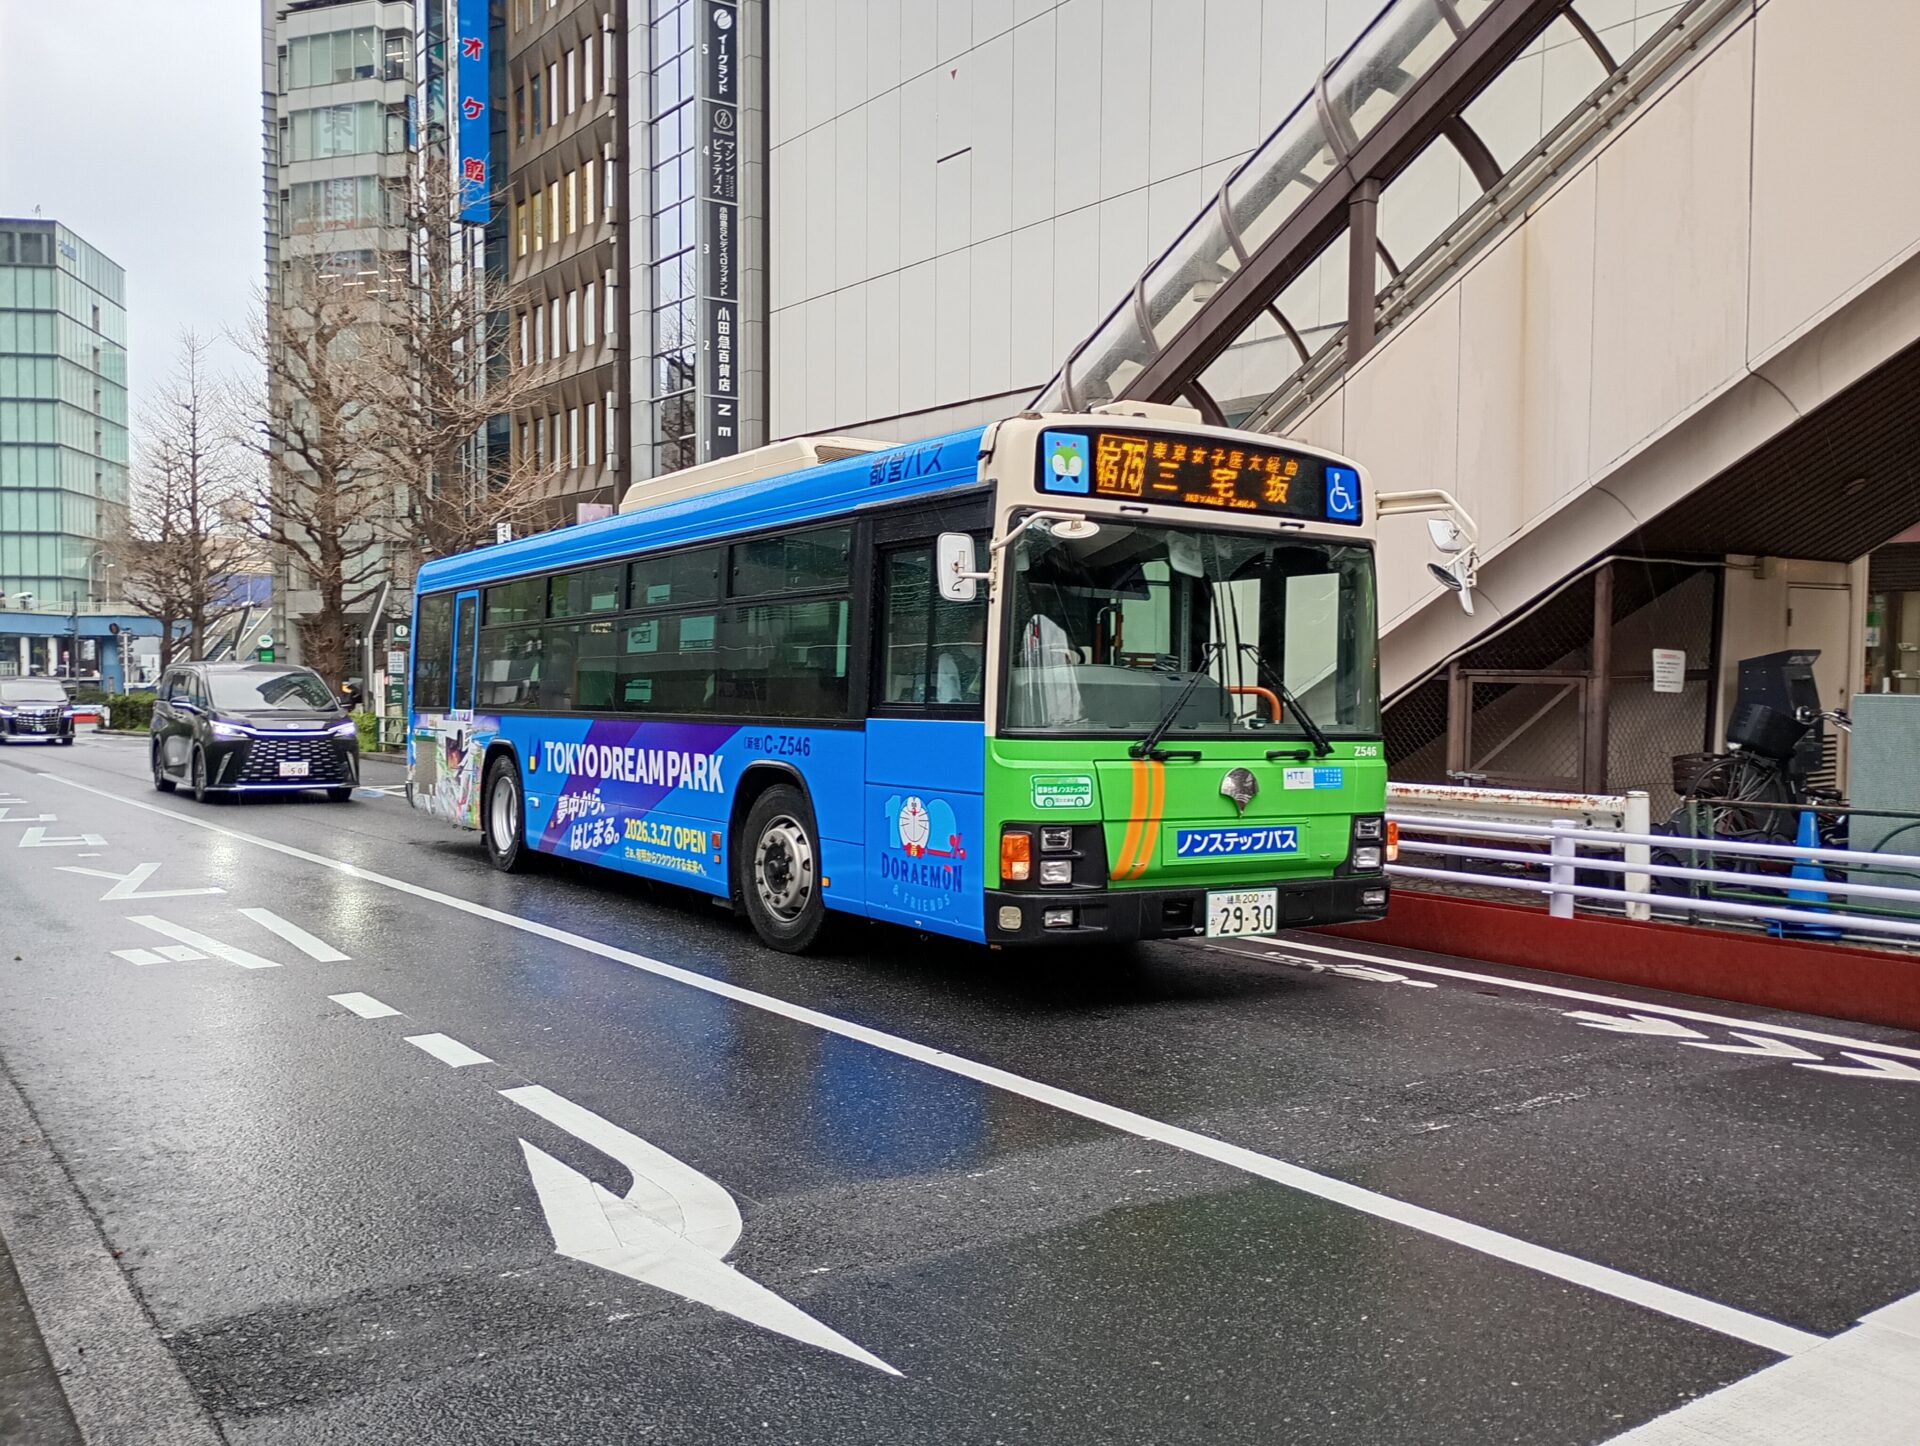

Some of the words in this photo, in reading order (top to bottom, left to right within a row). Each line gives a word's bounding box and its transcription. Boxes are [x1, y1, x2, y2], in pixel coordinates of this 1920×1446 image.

[702, 43, 709, 55] 5
[717, 34, 729, 95] イーグランド
[702, 145, 710, 156] 4
[712, 139, 724, 196] ピラティス
[723, 141, 736, 173] マシン
[703, 243, 710, 255] 3
[703, 340, 710, 351] 2
[717, 307, 731, 392] 小田急百貨店
[704, 440, 710, 451] 1
[1152, 441, 1299, 476] 東京女子医大経由
[869, 443, 944, 486] 都営バス
[1152, 461, 1292, 504] 三宅坂
[545, 741, 598, 778] TOKYO
[600, 747, 664, 787] DREAM
[667, 752, 725, 794] PARK
[1354, 746, 1377, 757] Z546
[1286, 771, 1304, 780] HTT
[556, 788, 606, 825] 夢中から、
[570, 817, 620, 851] はじまる。
[624, 817, 672, 848] 2026.3.27
[674, 828, 706, 854] OPEN
[1177, 830, 1297, 856] ノンステップバス
[881, 852, 963, 893] DORAEMON
[903, 892, 950, 912] FRIENDS
